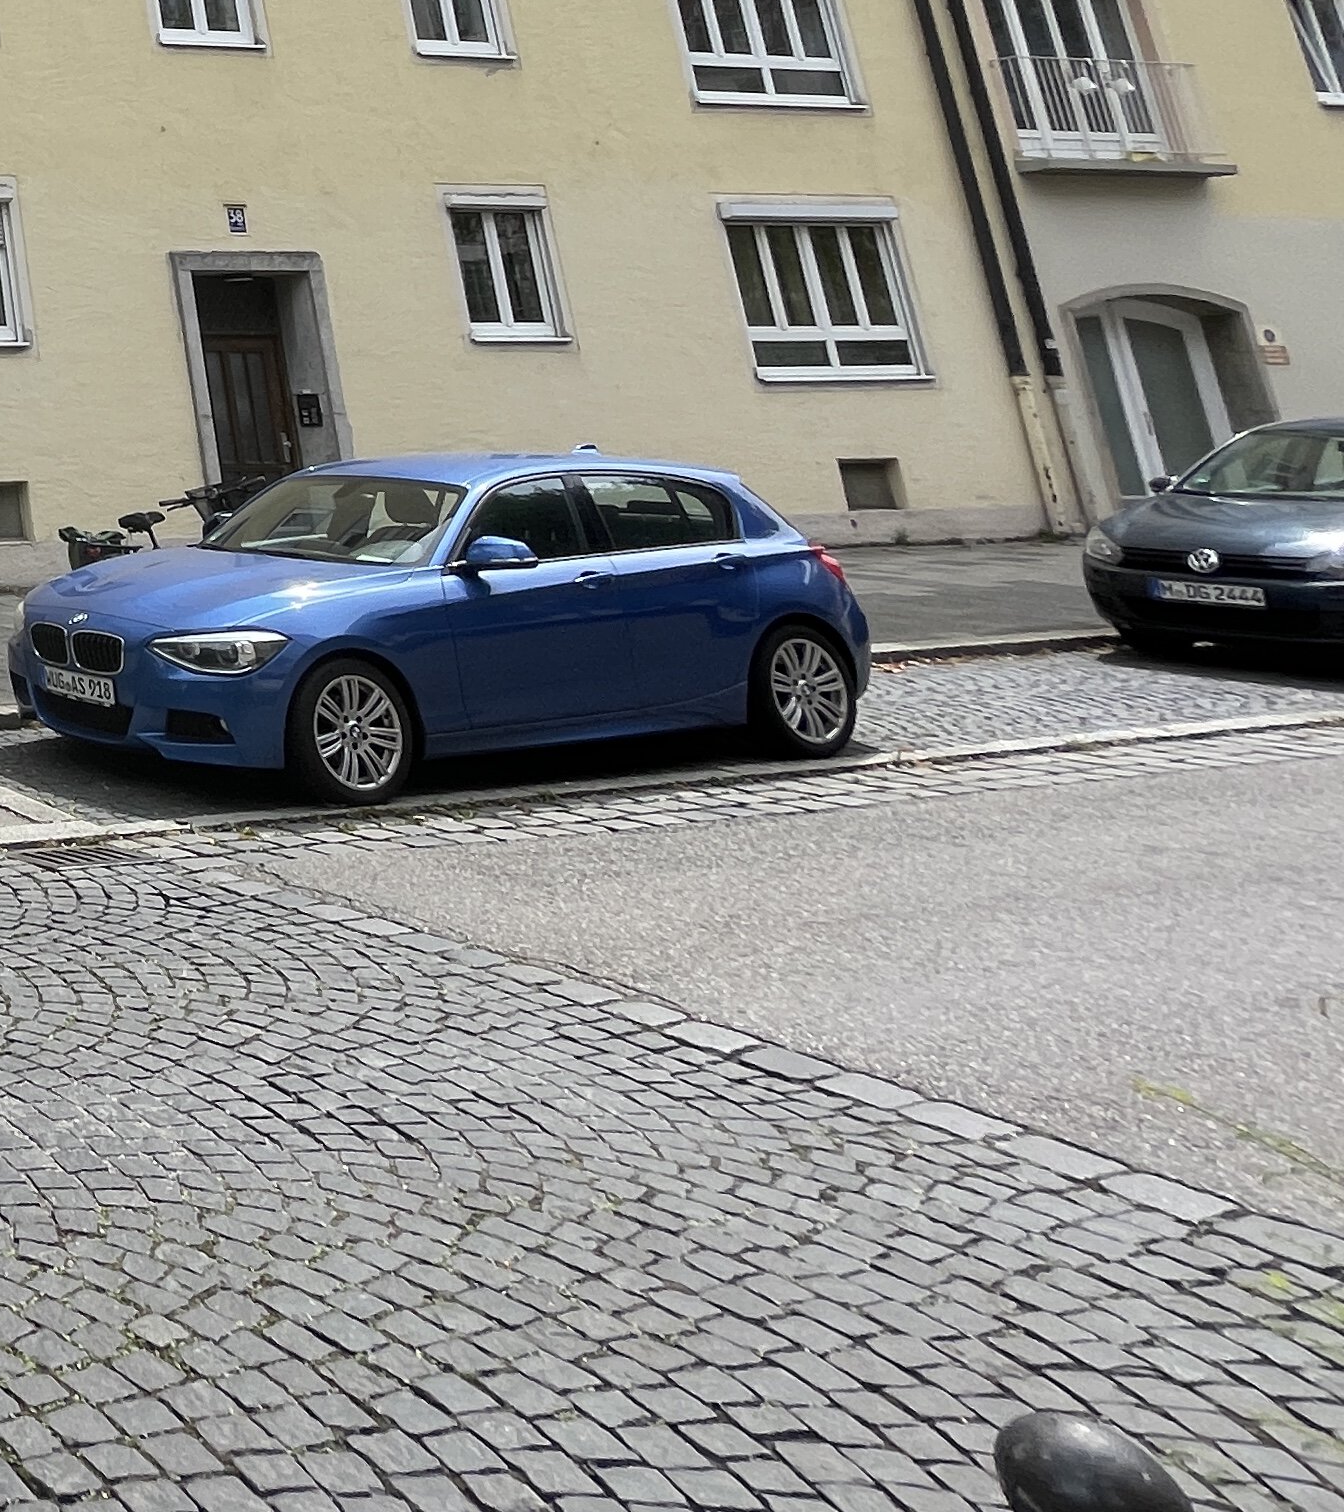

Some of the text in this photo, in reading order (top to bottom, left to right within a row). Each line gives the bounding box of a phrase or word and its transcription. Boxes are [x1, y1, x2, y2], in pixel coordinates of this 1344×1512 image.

[228, 209, 244, 224] 38
[71, 675, 86, 695] AS
[88, 678, 111, 700] 918
